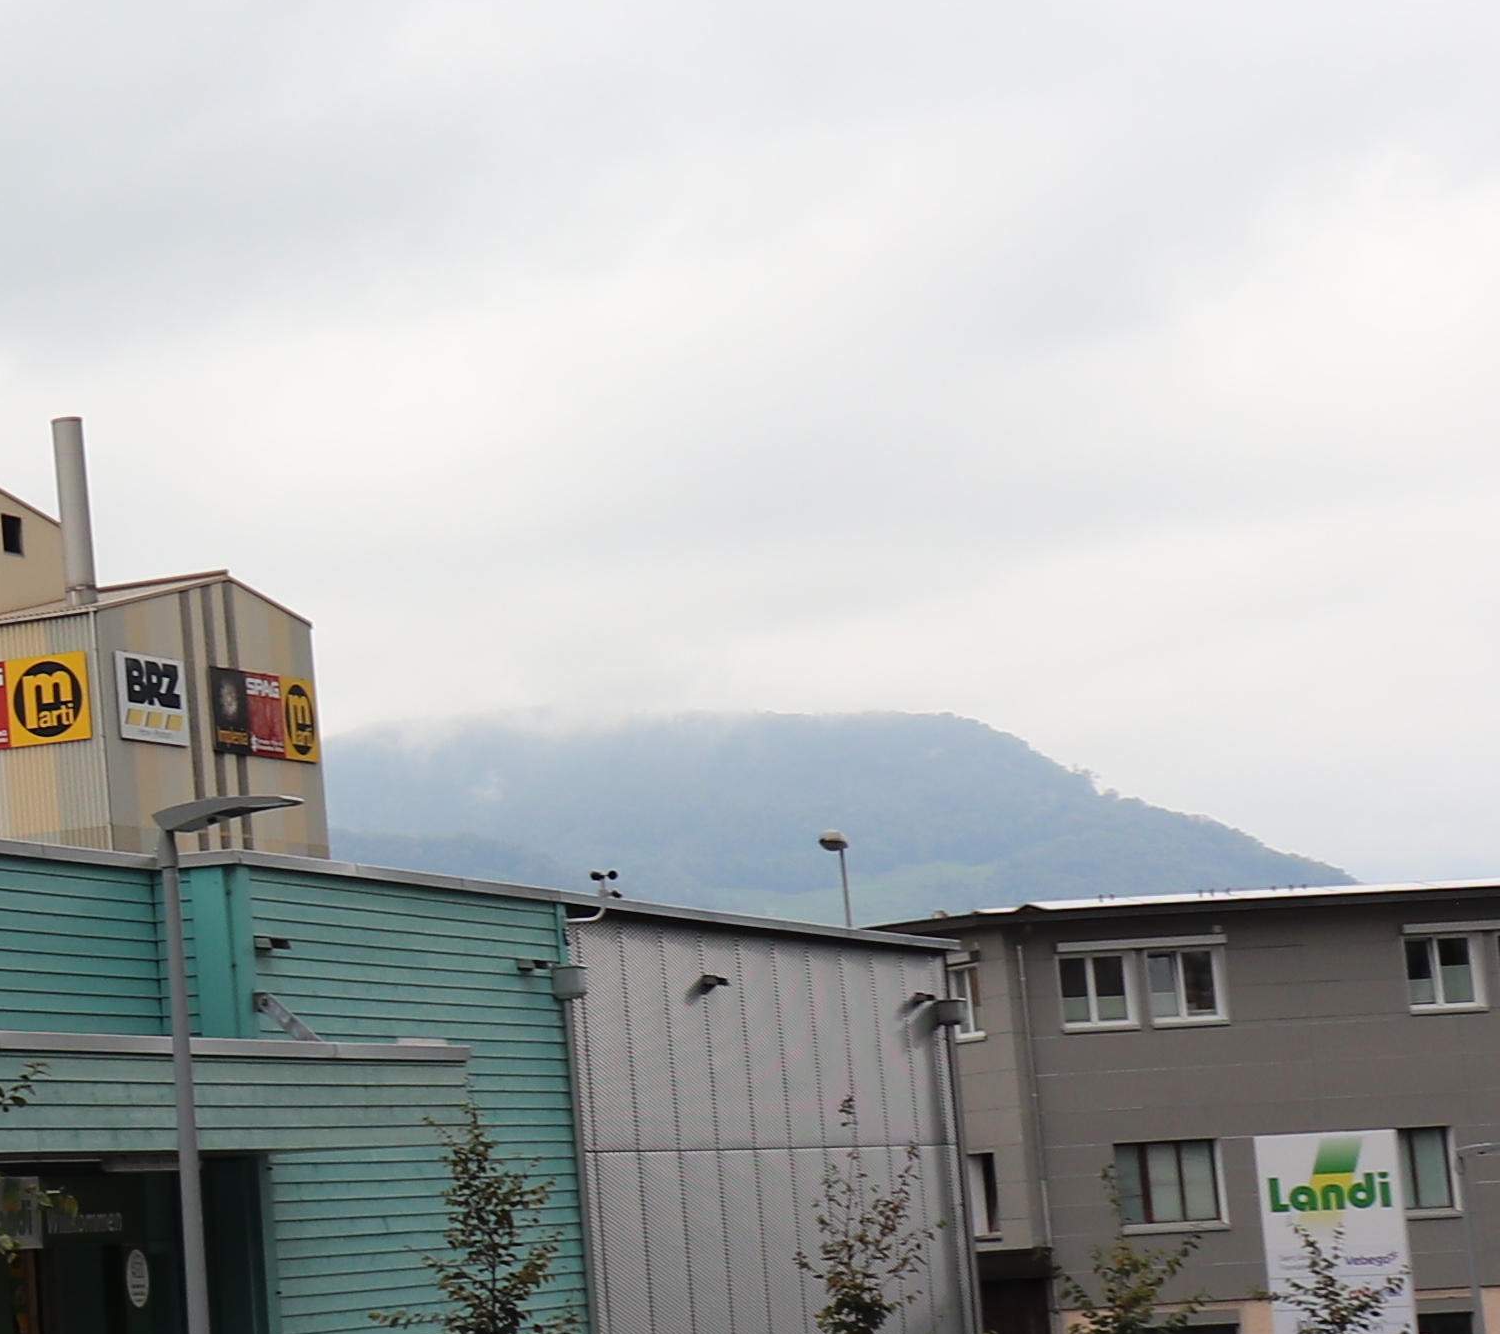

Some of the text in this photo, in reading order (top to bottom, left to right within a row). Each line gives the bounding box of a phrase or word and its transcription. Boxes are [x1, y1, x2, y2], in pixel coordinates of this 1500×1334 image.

[125, 657, 181, 709] BRZ
[245, 677, 280, 699] SPAG
[1267, 1171, 1393, 1212] Landi
